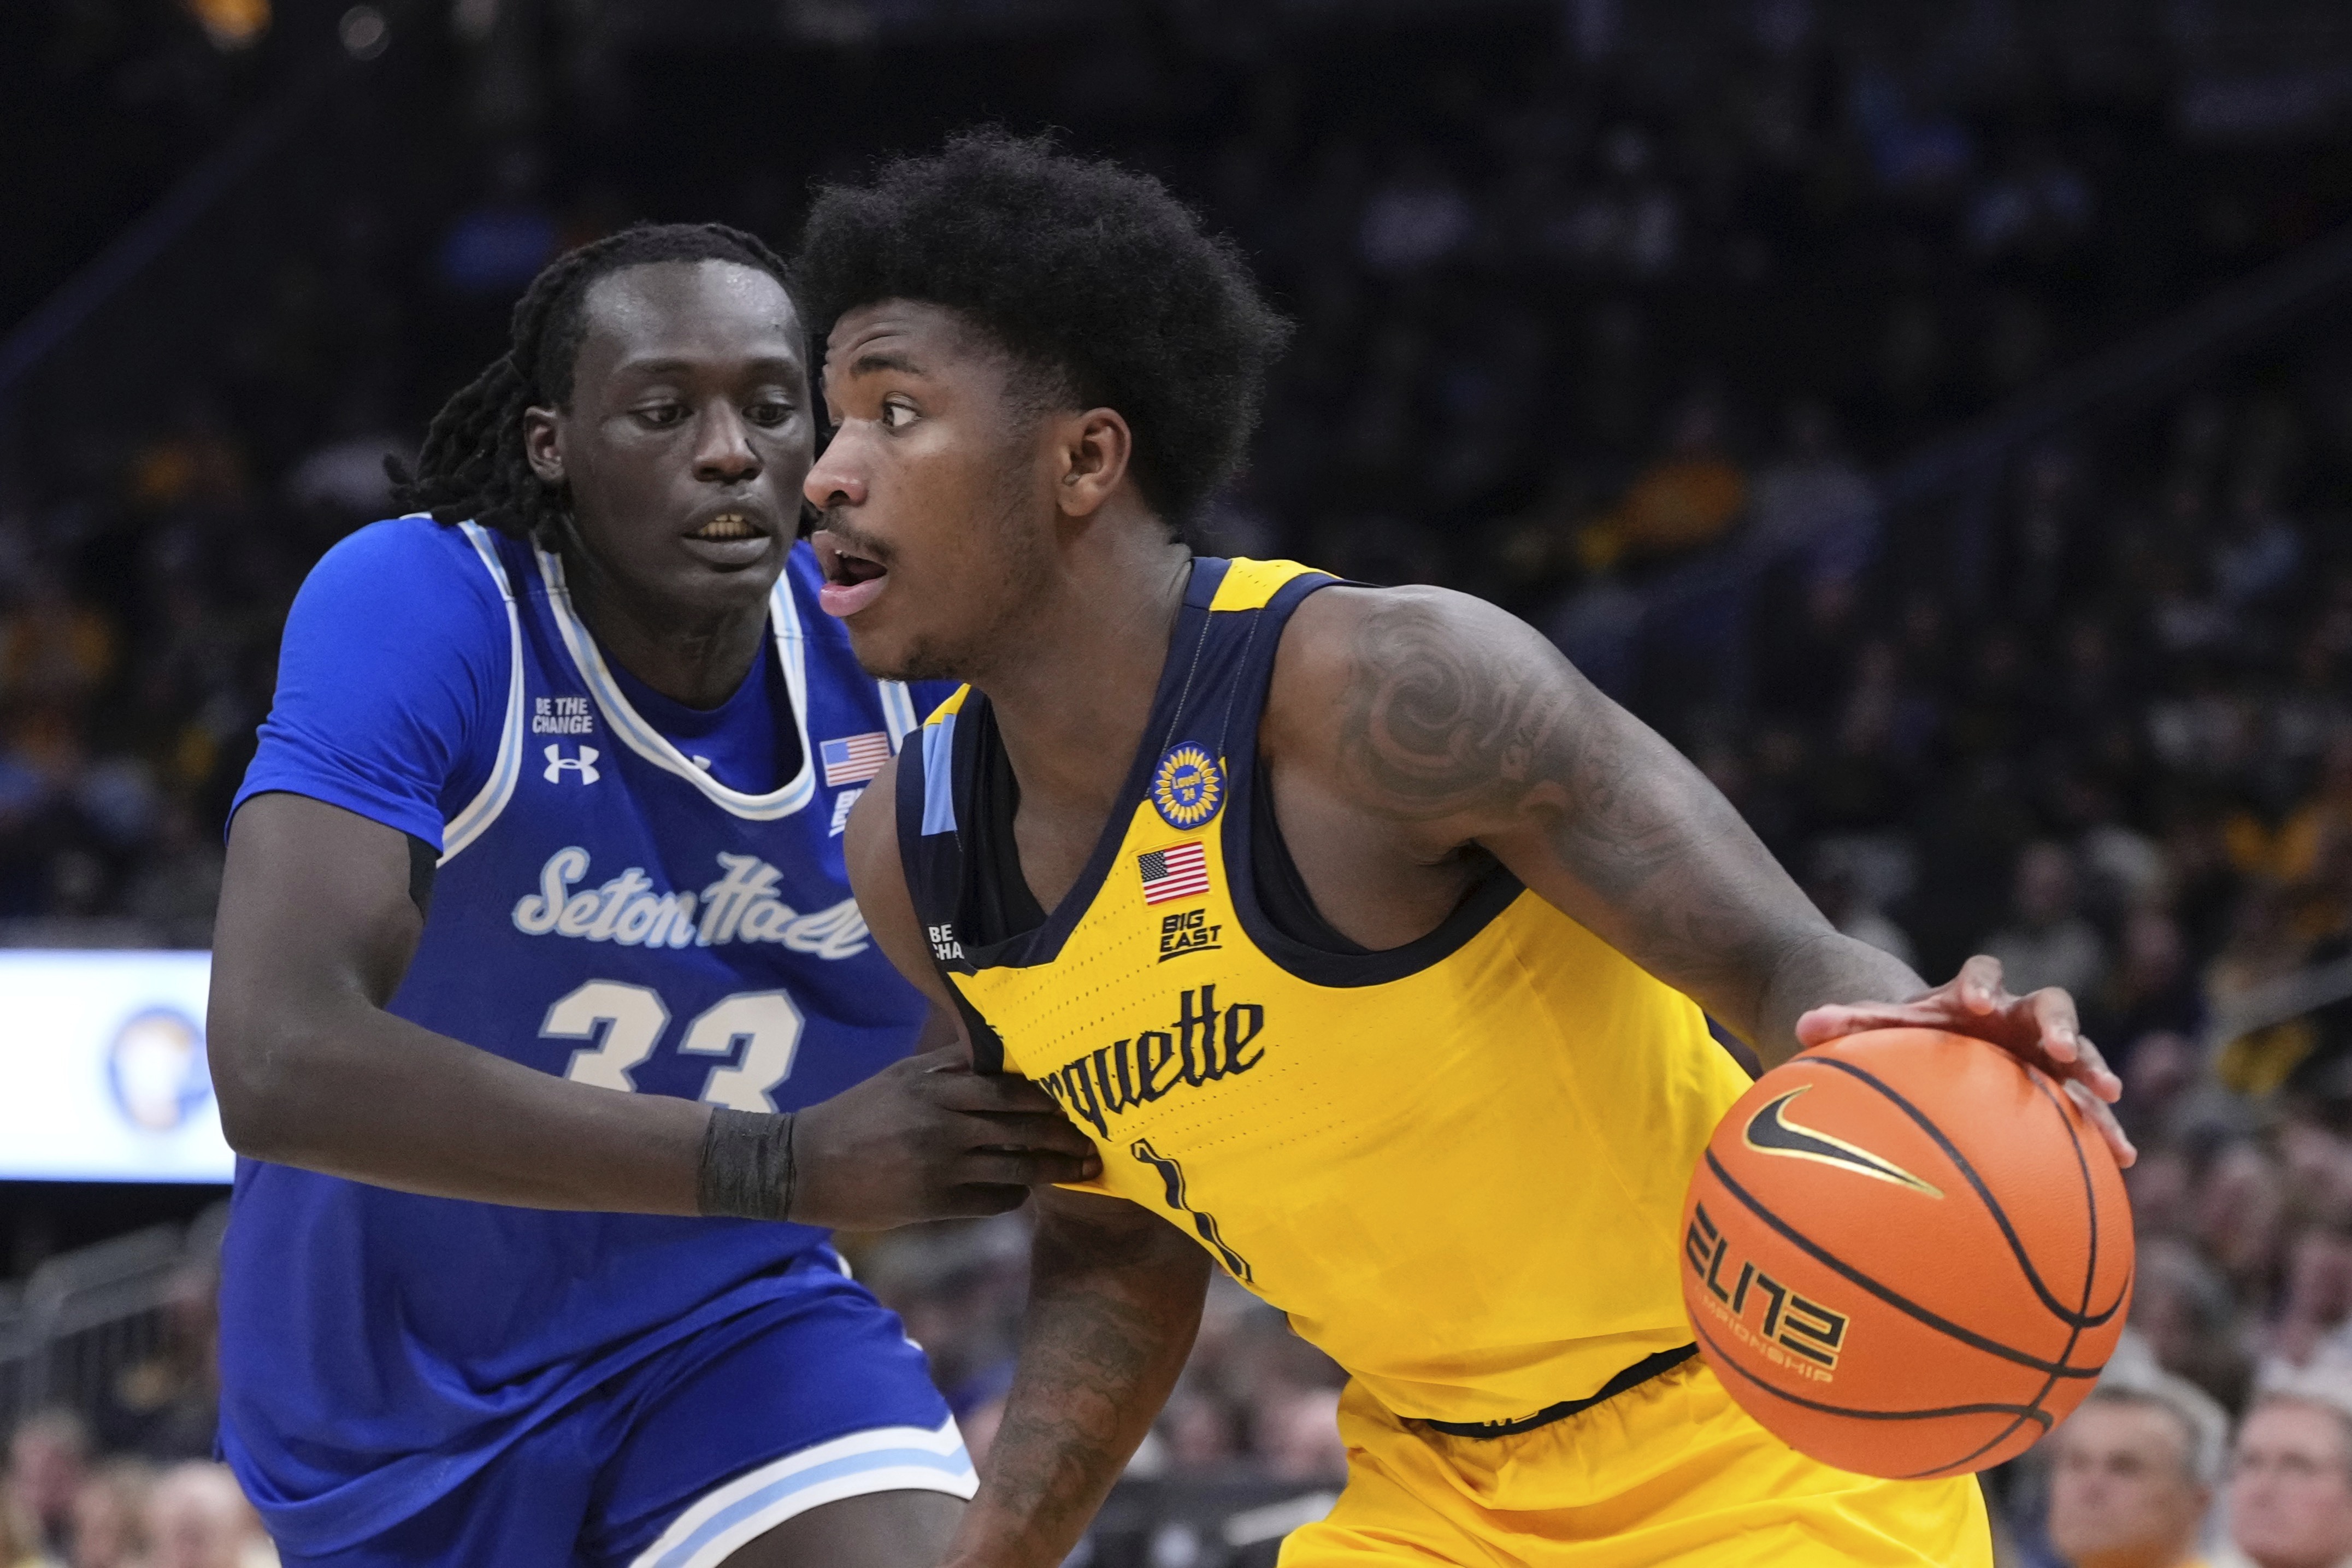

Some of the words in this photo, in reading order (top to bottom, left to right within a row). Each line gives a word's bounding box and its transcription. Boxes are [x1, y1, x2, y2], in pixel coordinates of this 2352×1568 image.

[536, 697, 552, 716] BE
[555, 697, 588, 716] THE
[532, 715, 593, 734] CHANGE
[1182, 787, 1196, 801] 24
[512, 846, 695, 949] Seton
[697, 851, 871, 960] Hall
[928, 923, 954, 943] BE
[1162, 908, 1205, 934] BIG
[1159, 924, 1223, 953] EAST
[538, 978, 805, 1115] 33
[1031, 983, 1266, 1142] rquette
[1685, 1199, 1850, 1371] ELITE
